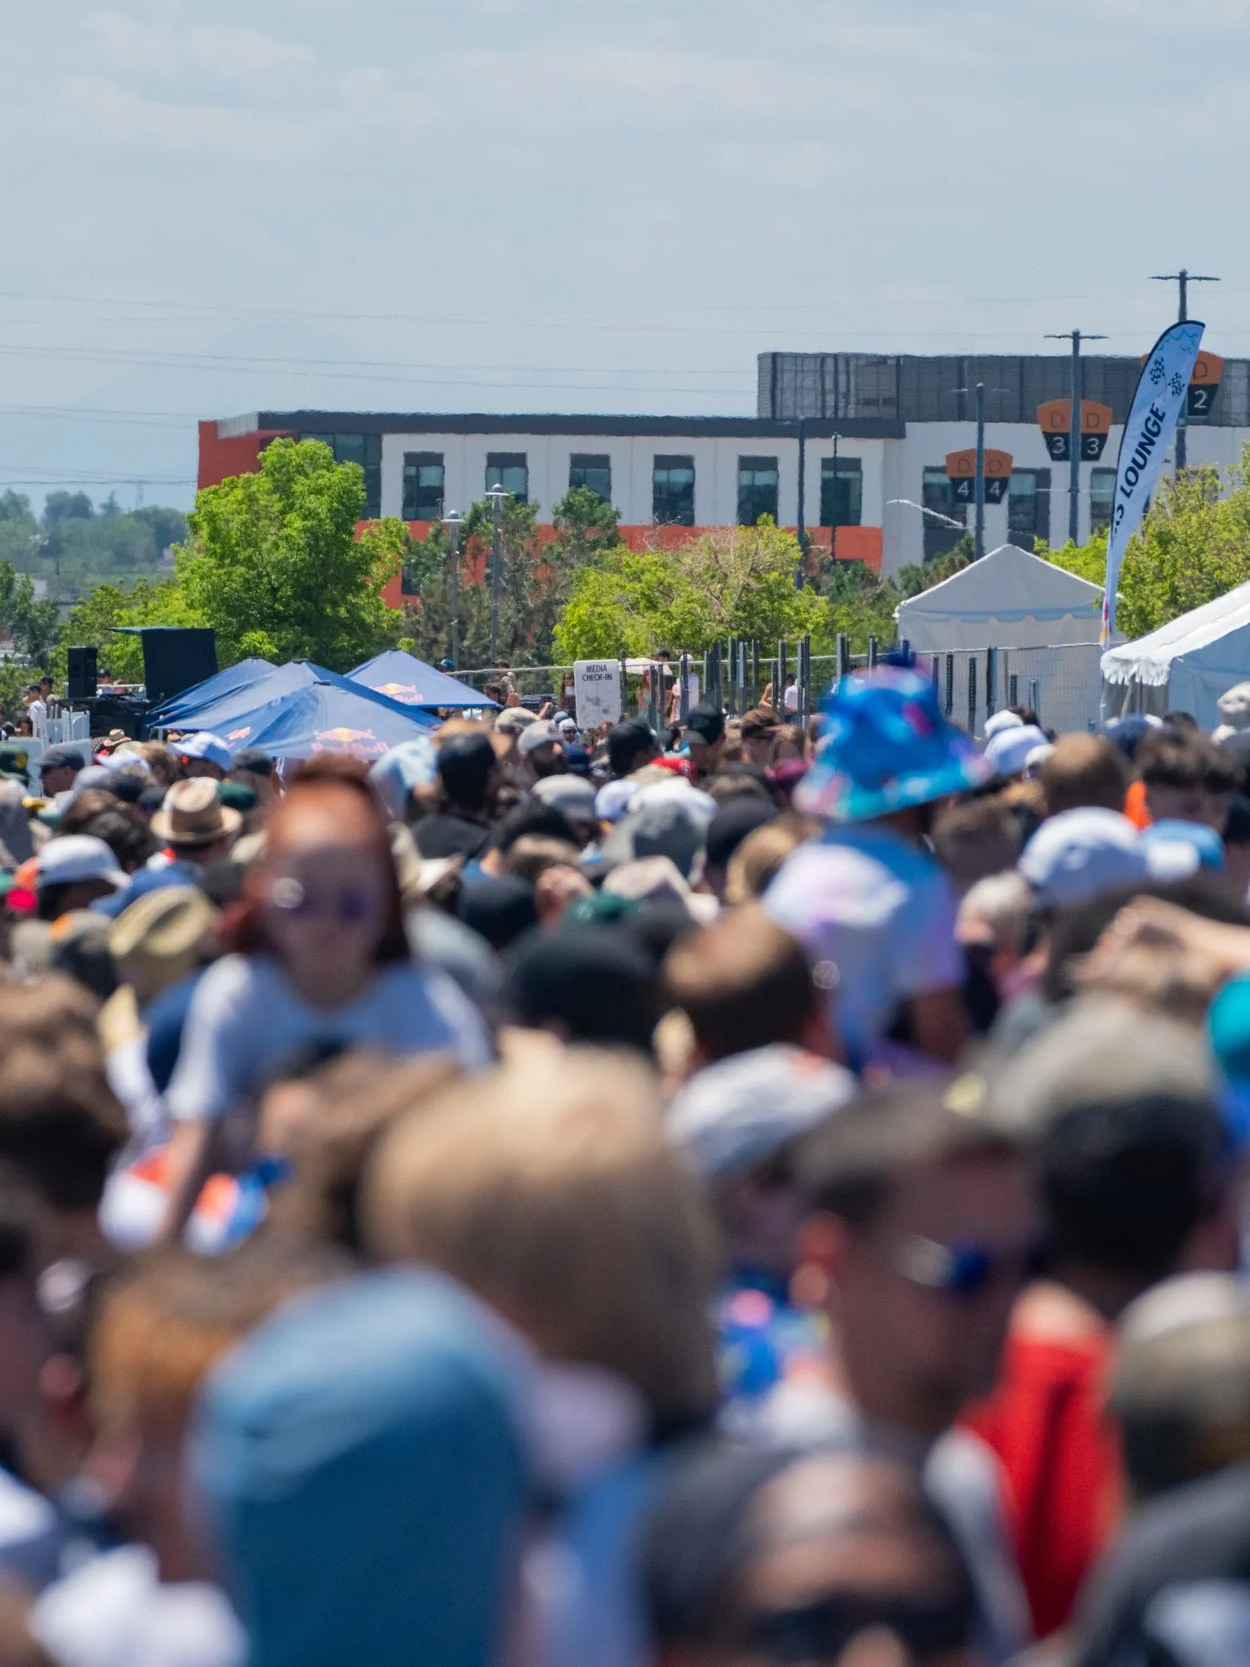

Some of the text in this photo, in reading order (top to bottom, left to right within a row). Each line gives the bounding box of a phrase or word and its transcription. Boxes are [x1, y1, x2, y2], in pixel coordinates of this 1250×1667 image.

[1194, 390, 1207, 409] 2
[1052, 436, 1065, 454] 3
[1087, 437, 1099, 455] 3
[1120, 402, 1166, 499] LOUNGE
[957, 479, 969, 496] 4
[989, 480, 1001, 496] 4
[586, 664, 607, 673] MEDIA
[582, 673, 613, 682] CHECK-IN
